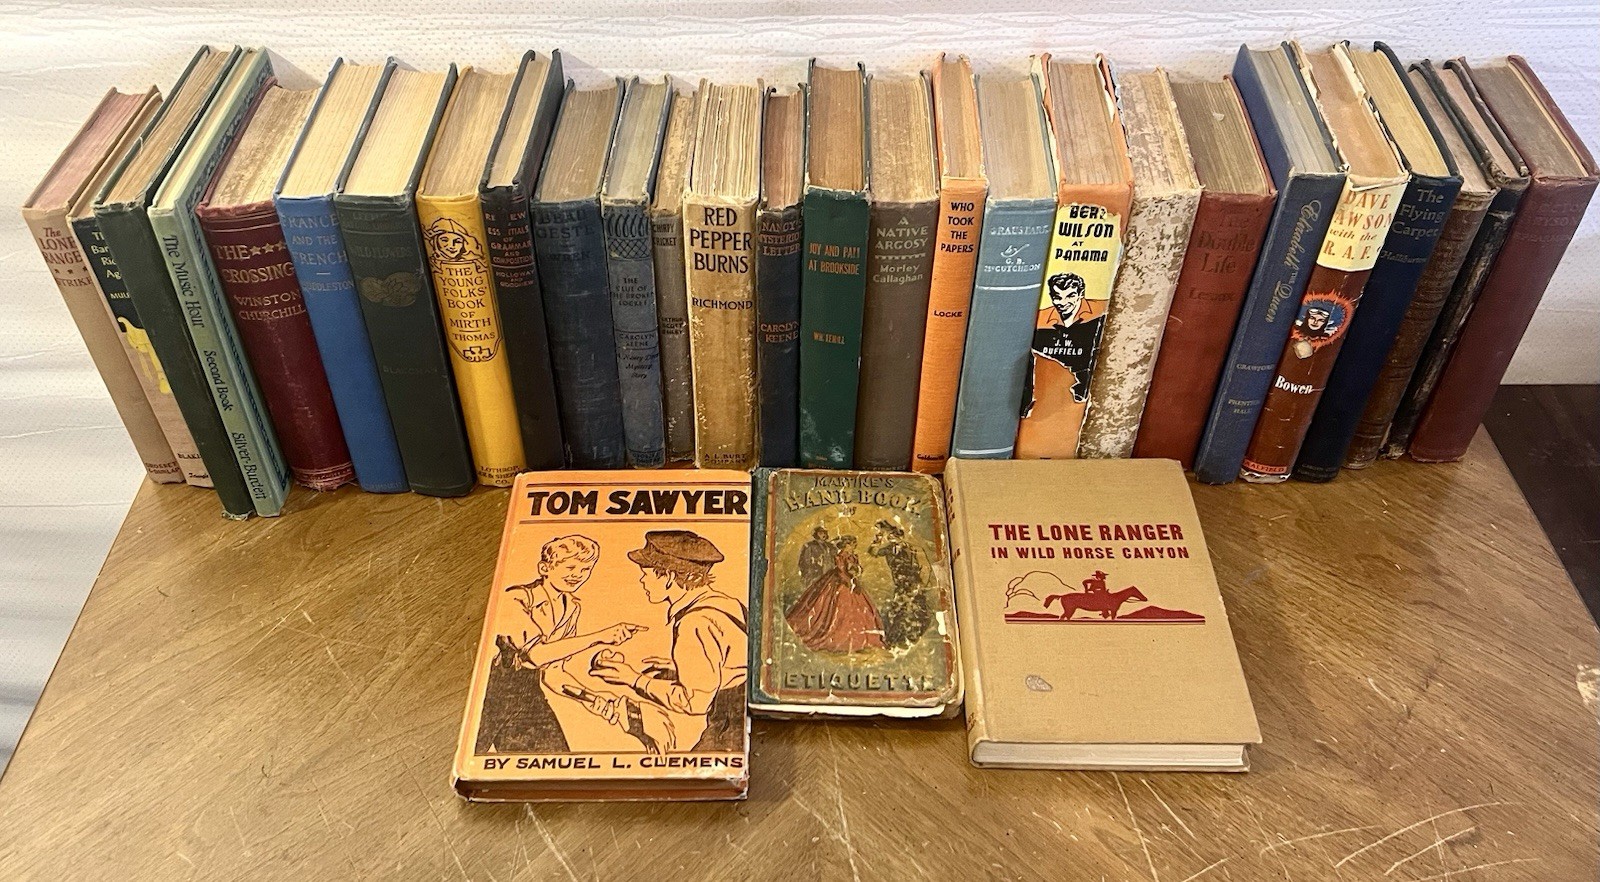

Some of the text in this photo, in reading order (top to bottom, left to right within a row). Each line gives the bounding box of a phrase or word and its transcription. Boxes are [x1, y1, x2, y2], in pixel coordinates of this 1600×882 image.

[1343, 190, 1392, 210] DAVE
[1417, 188, 1444, 203] The
[951, 202, 974, 212] WHO
[1399, 204, 1446, 224] Flying
[280, 213, 341, 229] FRANCE
[541, 209, 586, 224] BEAU
[704, 206, 738, 228] RED
[897, 216, 909, 225] A
[948, 216, 974, 226] TOOK
[1333, 208, 1393, 231] AWSON
[43, 227, 61, 237] The
[536, 224, 595, 239] GESTE
[876, 226, 929, 238] NATIVE
[950, 230, 968, 240] THE
[1059, 222, 1114, 239] WILSON
[1283, 199, 1322, 271] Elizabeth
[1329, 226, 1378, 242] with the
[38, 236, 77, 251] LONE
[292, 234, 337, 246] AND THE
[491, 240, 532, 251] GRAMMAR
[690, 228, 753, 251] PEPPER
[875, 237, 929, 250] ARGOSY
[1197, 230, 1256, 252] Double
[216, 244, 251, 261] THE
[809, 243, 822, 255] JOY
[825, 244, 840, 257] AND
[941, 243, 974, 253] PAPERS
[1055, 248, 1109, 262] PANAMA
[1322, 239, 1373, 260] R. A. F.
[42, 250, 83, 265] RANGE
[291, 250, 348, 266] FRENCH
[694, 252, 749, 274] BURNS
[1005, 257, 1014, 265] G.
[1200, 252, 1236, 274] Life
[222, 262, 294, 283] CROSSING
[445, 267, 473, 277] THE
[808, 260, 860, 275] AT BROOKSIDE
[880, 264, 920, 274] Morley
[54, 277, 93, 287] STRIKE
[163, 234, 205, 328] The Music Hour
[440, 276, 484, 288] YOUNG
[873, 273, 923, 286] Callaghan
[234, 289, 301, 307] WINSTON
[443, 286, 488, 298] FOLKS'
[447, 299, 486, 310] BOOK
[692, 297, 753, 310] RICHMOND
[1264, 280, 1293, 323] Queen
[239, 304, 306, 321] CHURCHILL
[460, 311, 476, 319] OF
[934, 310, 963, 318] LOCKE
[450, 317, 491, 330] MIRTH
[452, 331, 496, 342] THOMAS
[765, 330, 799, 343] KEENE
[1054, 338, 1074, 347] J. W.
[1043, 346, 1084, 356] DUFFIELD
[204, 350, 232, 412] Second Book
[1274, 375, 1314, 395] Bowen
[814, 476, 895, 489] MARTINE'S
[527, 490, 748, 516] TOM SAWYER
[988, 524, 1184, 541] THE LONE RANGER
[991, 546, 1190, 559] IN WILD HORSE CANYON
[484, 756, 743, 770] BY SAMUEL L. CLEMENS
